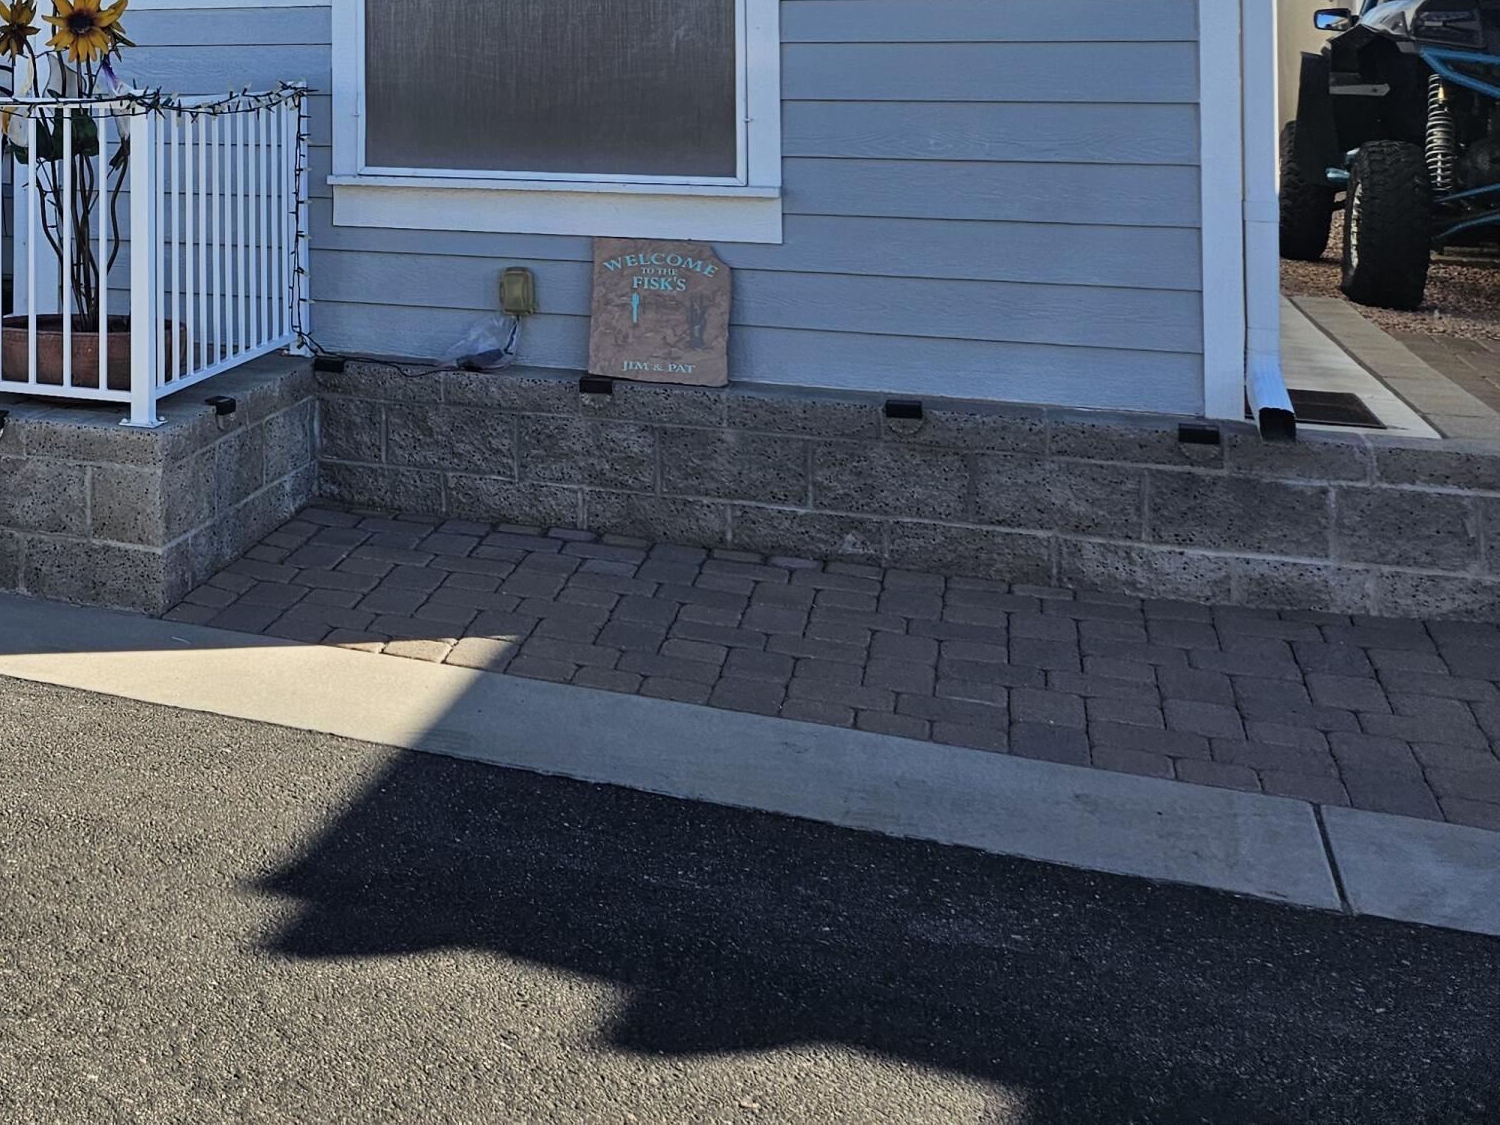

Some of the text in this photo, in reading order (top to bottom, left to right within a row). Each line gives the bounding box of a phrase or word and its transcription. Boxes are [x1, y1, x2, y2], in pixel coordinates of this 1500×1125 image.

[603, 252, 719, 277] WELCOME
[641, 267, 677, 276] TO THE
[632, 276, 687, 291] FISK'S
[621, 360, 696, 373] JIM & PAT
